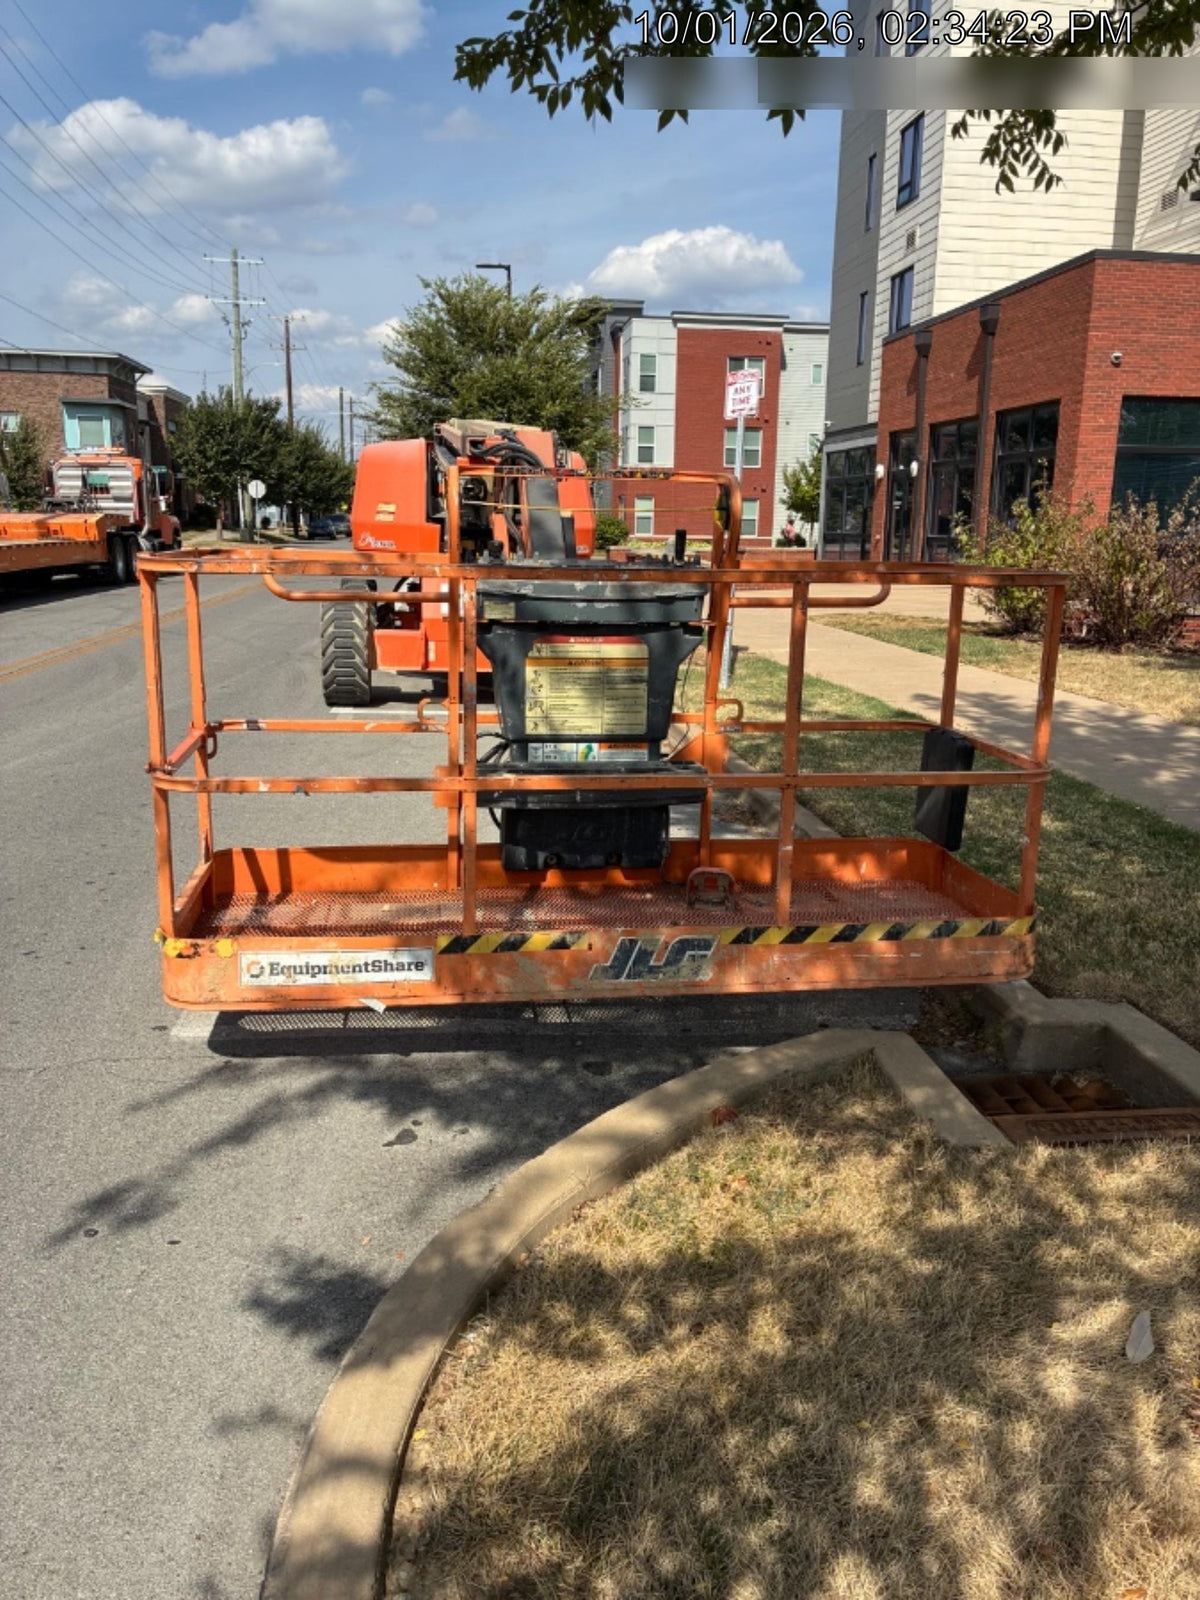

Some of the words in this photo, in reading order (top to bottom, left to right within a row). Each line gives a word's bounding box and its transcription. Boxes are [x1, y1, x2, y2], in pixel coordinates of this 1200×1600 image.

[734, 384, 752, 394] ANY
[731, 396, 751, 407] TIME
[268, 959, 427, 979] EquipmentShare
